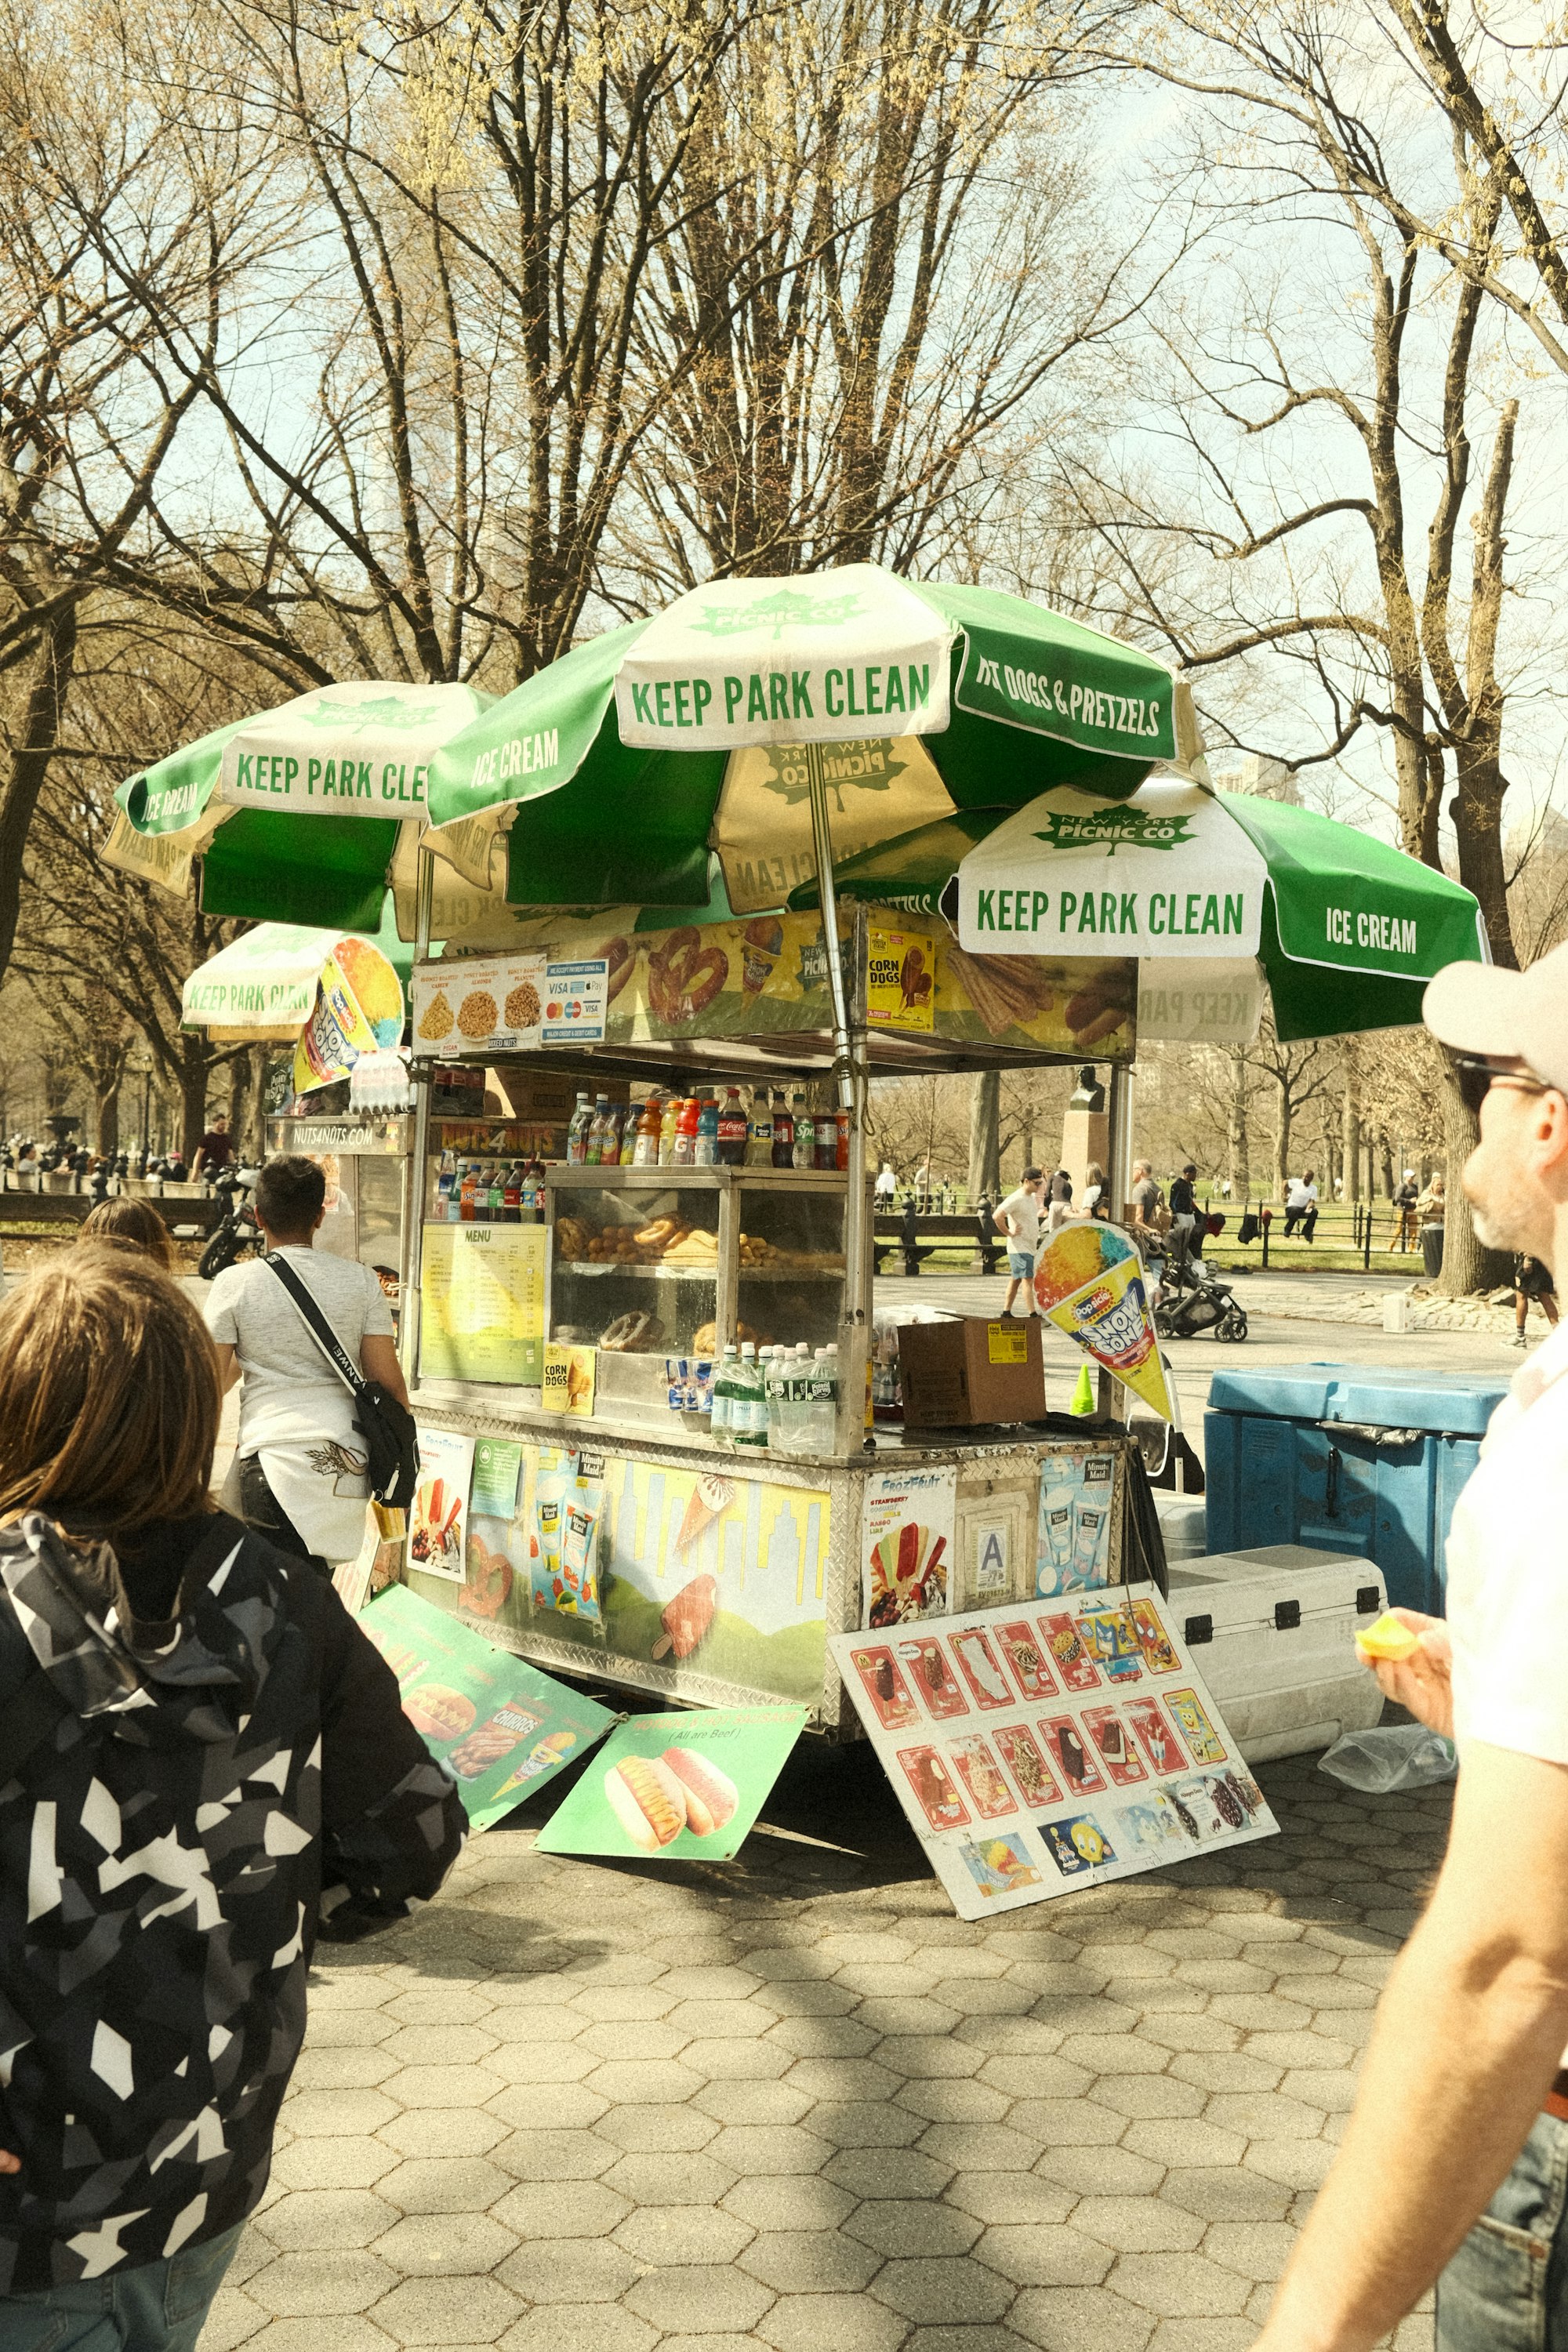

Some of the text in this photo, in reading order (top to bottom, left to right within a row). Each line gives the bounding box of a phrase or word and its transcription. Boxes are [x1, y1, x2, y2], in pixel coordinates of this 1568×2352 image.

[631, 678, 712, 728] KEEP
[724, 670, 815, 724] PARK
[824, 663, 931, 717] CLEAN
[1004, 665, 1053, 711] DOGS
[1053, 680, 1069, 717] &
[1069, 684, 1160, 737] PRETZELS
[470, 728, 559, 789] ICE CREAM
[236, 753, 427, 803] KEEP PARK CLE
[140, 782, 198, 822] ICE CREAM
[1142, 827, 1176, 839] CO
[977, 889, 1244, 935] KEEP PARK CLEAN
[1326, 906, 1417, 955] ICE CREAM
[804, 946, 823, 957] NEW
[869, 959, 899, 973] CORN
[869, 971, 900, 984] DOGS
[549, 982, 568, 994] VISA
[591, 980, 603, 993] Pay
[188, 983, 309, 1012] KEEP PARK CLEAN
[585, 1004, 598, 1013] VISA
[317, 993, 359, 1065] SNOW
[312, 1011, 343, 1070] CONE
[488, 1038, 517, 1047] MIXED NUTS
[292, 1126, 373, 1145] NUTS4NUTS.COM
[441, 1124, 556, 1154] NUTS 4 NUTS
[675, 1136, 688, 1153] G
[464, 1229, 492, 1243] MENU
[1074, 1291, 1110, 1318] Popsicle
[1079, 1286, 1140, 1343] SNOW
[1094, 1316, 1145, 1356] CONE
[545, 1364, 568, 1376] CORN
[545, 1375, 568, 1386] DOGS
[811, 1381, 830, 1389] Poland
[812, 1387, 831, 1396] Spring
[580, 1452, 604, 1467] Minute
[1087, 1462, 1109, 1471] Minute
[583, 1463, 601, 1475] Maid
[1089, 1470, 1106, 1479] Maid
[869, 1496, 909, 1506] STRAWBERRY
[543, 1505, 557, 1514] Minute
[572, 1515, 587, 1529] Minute
[573, 1523, 585, 1534] Maid
[981, 1534, 1004, 1570] A
[492, 1710, 539, 1735] CHURROS
[690, 1731, 708, 1740] are
